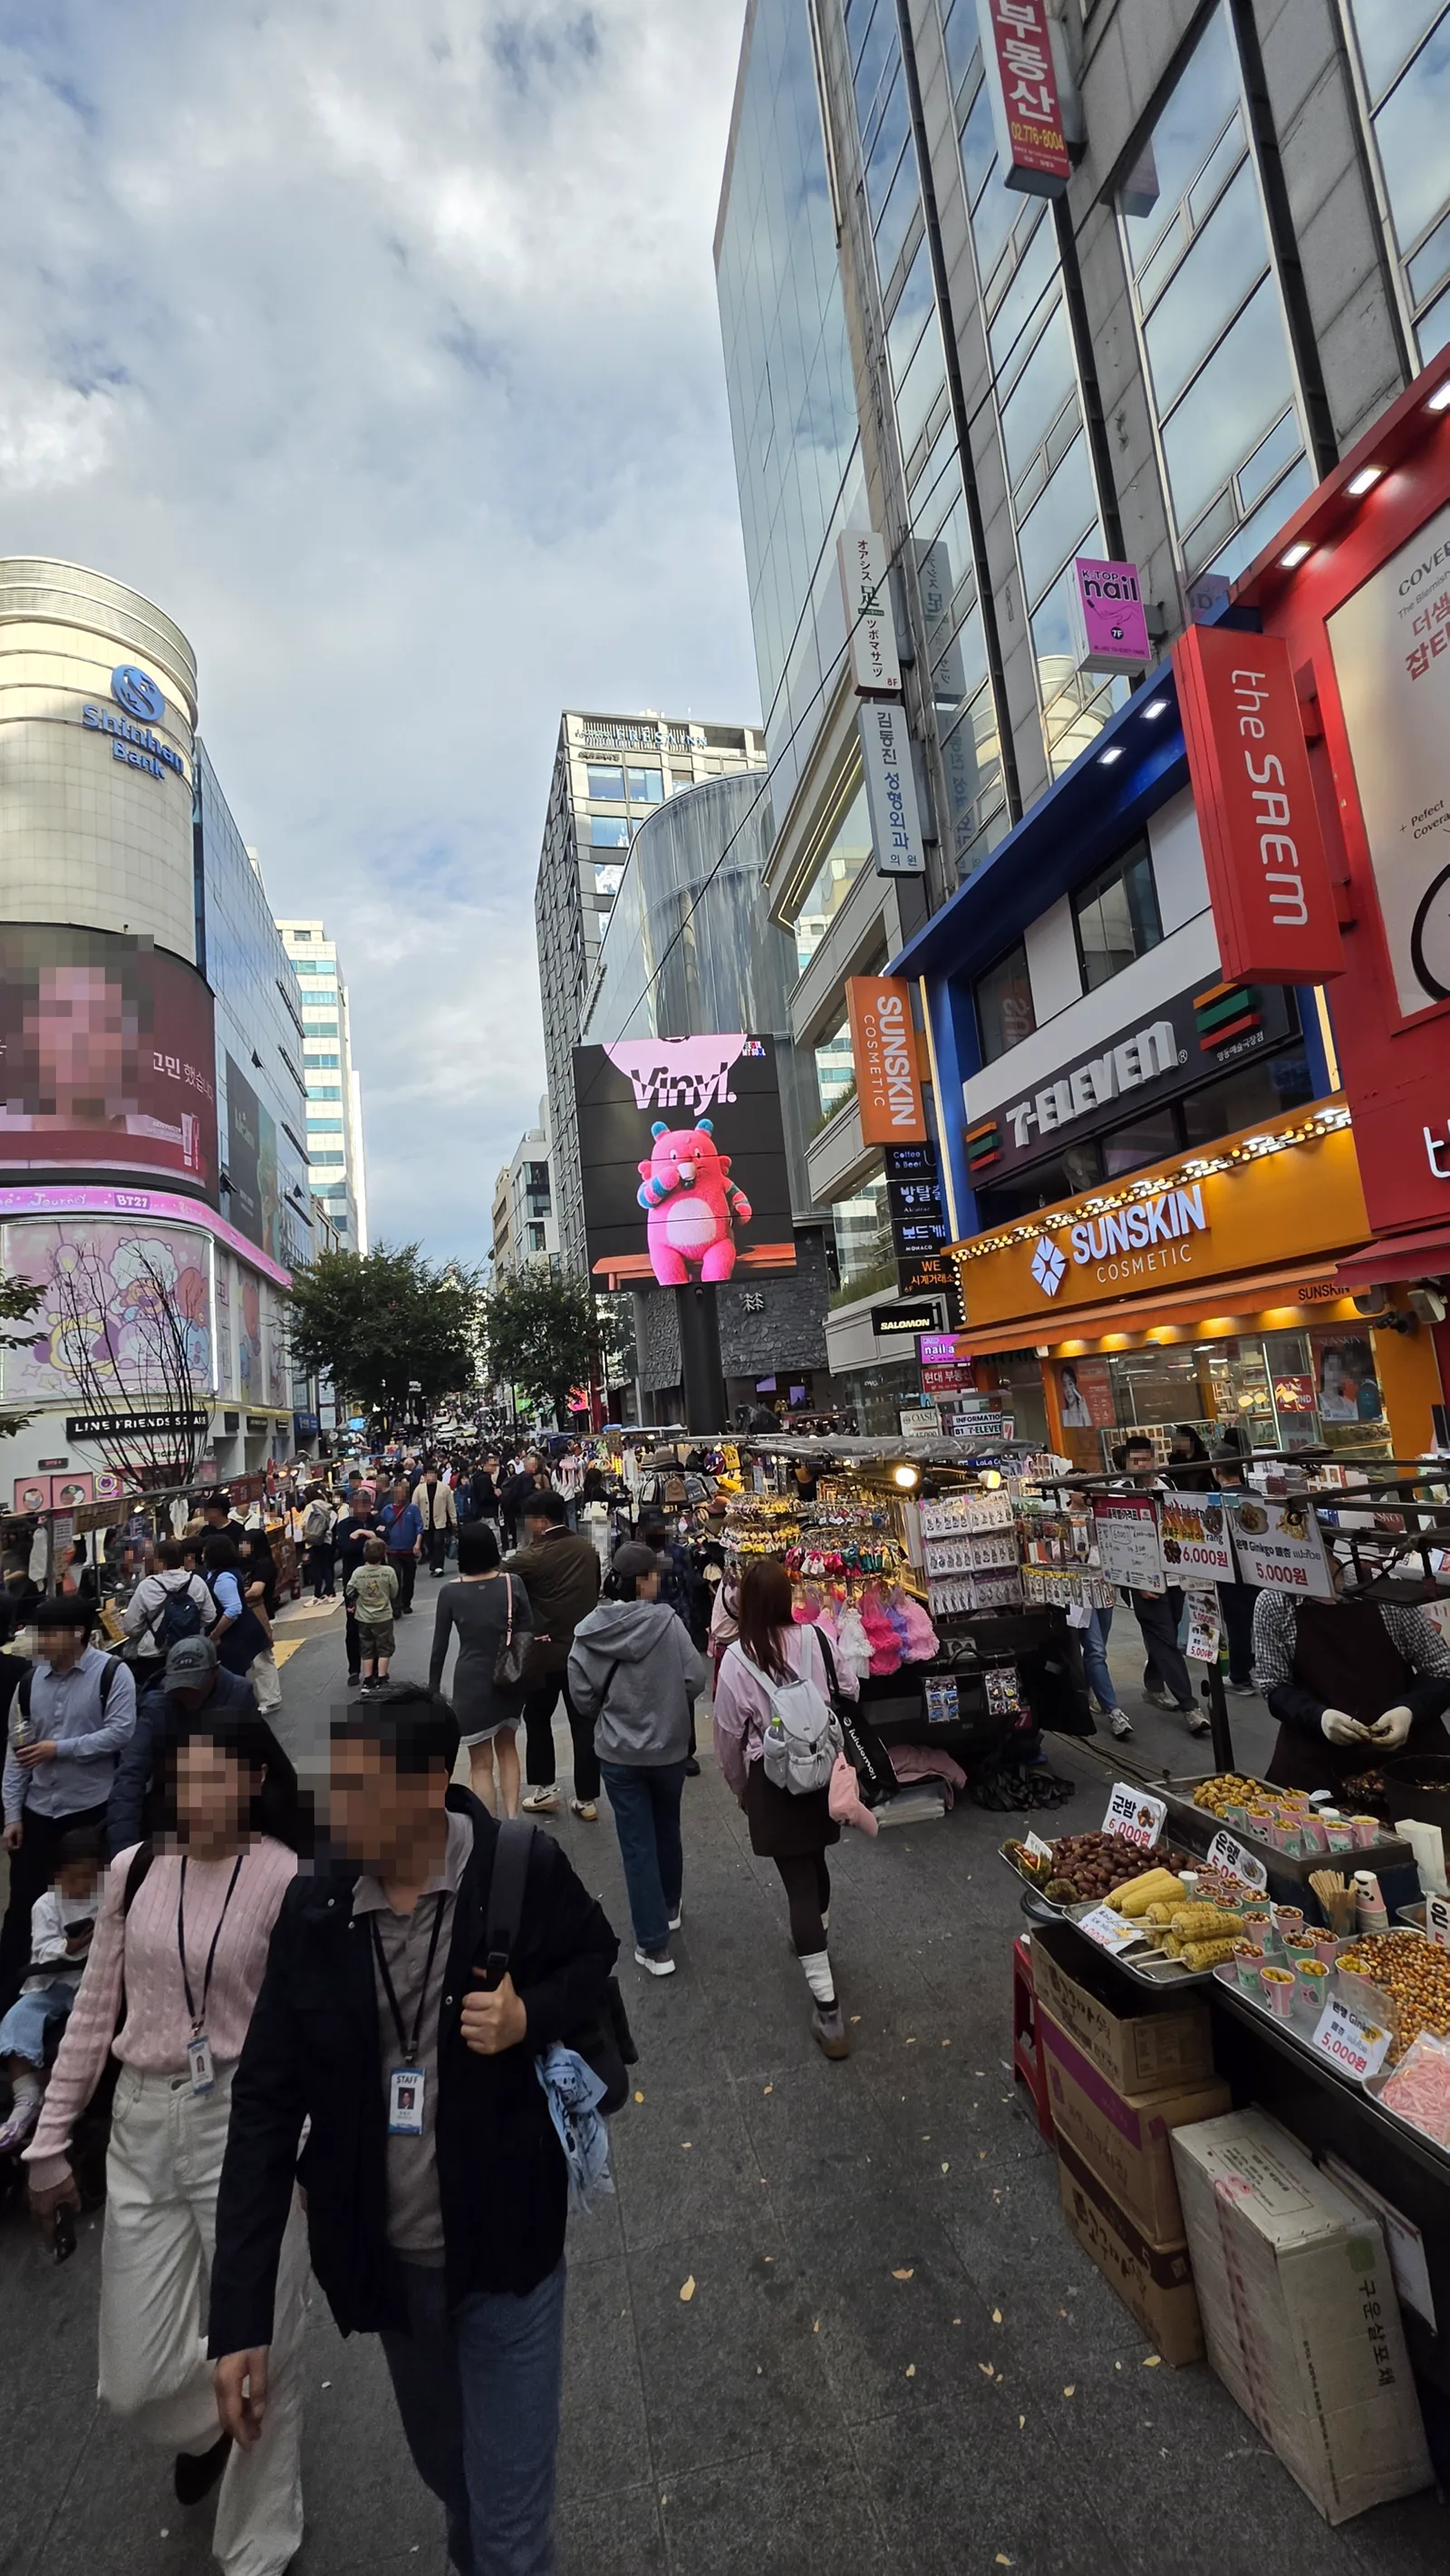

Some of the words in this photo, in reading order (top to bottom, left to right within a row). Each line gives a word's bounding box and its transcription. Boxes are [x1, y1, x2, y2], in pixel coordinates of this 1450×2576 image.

[997, 2, 1056, 123] 부동산
[1083, 576, 1139, 602] nail
[1110, 629, 1124, 640] 7F
[886, 677, 898, 687] 8F
[1231, 669, 1270, 740] the
[82, 703, 185, 774] Shinhan
[876, 712, 897, 766] 김동진
[111, 738, 166, 780] Bank
[884, 771, 910, 850] 성형외과
[864, 1014, 885, 1107] COSMETIC
[876, 995, 917, 1126] SUNSKIN
[631, 1061, 738, 1117] Vinyl.
[115, 1194, 149, 1209] BT21
[1070, 1185, 1207, 1264] SUNSKIN
[921, 1260, 942, 1272] WE
[1097, 1244, 1193, 1283] COSMETIC
[911, 1273, 955, 1285] 시계거래소
[880, 1318, 931, 1330] SALOMON
[924, 1345, 946, 1355] nail
[924, 1372, 943, 1384] 현대
[75, 1420, 111, 1432] LINE
[115, 1418, 170, 1429] FRIENDS
[1183, 1546, 1229, 1568] 6,000원
[1250, 1541, 1275, 1557] Ginkgo
[1255, 1562, 1309, 1586] 5,000원
[1112, 1794, 1136, 1819] 군밤
[1215, 1832, 1241, 1865] 은행
[1321, 2031, 1368, 2074] 5,000원
[396, 2074, 419, 2085] STAFF
